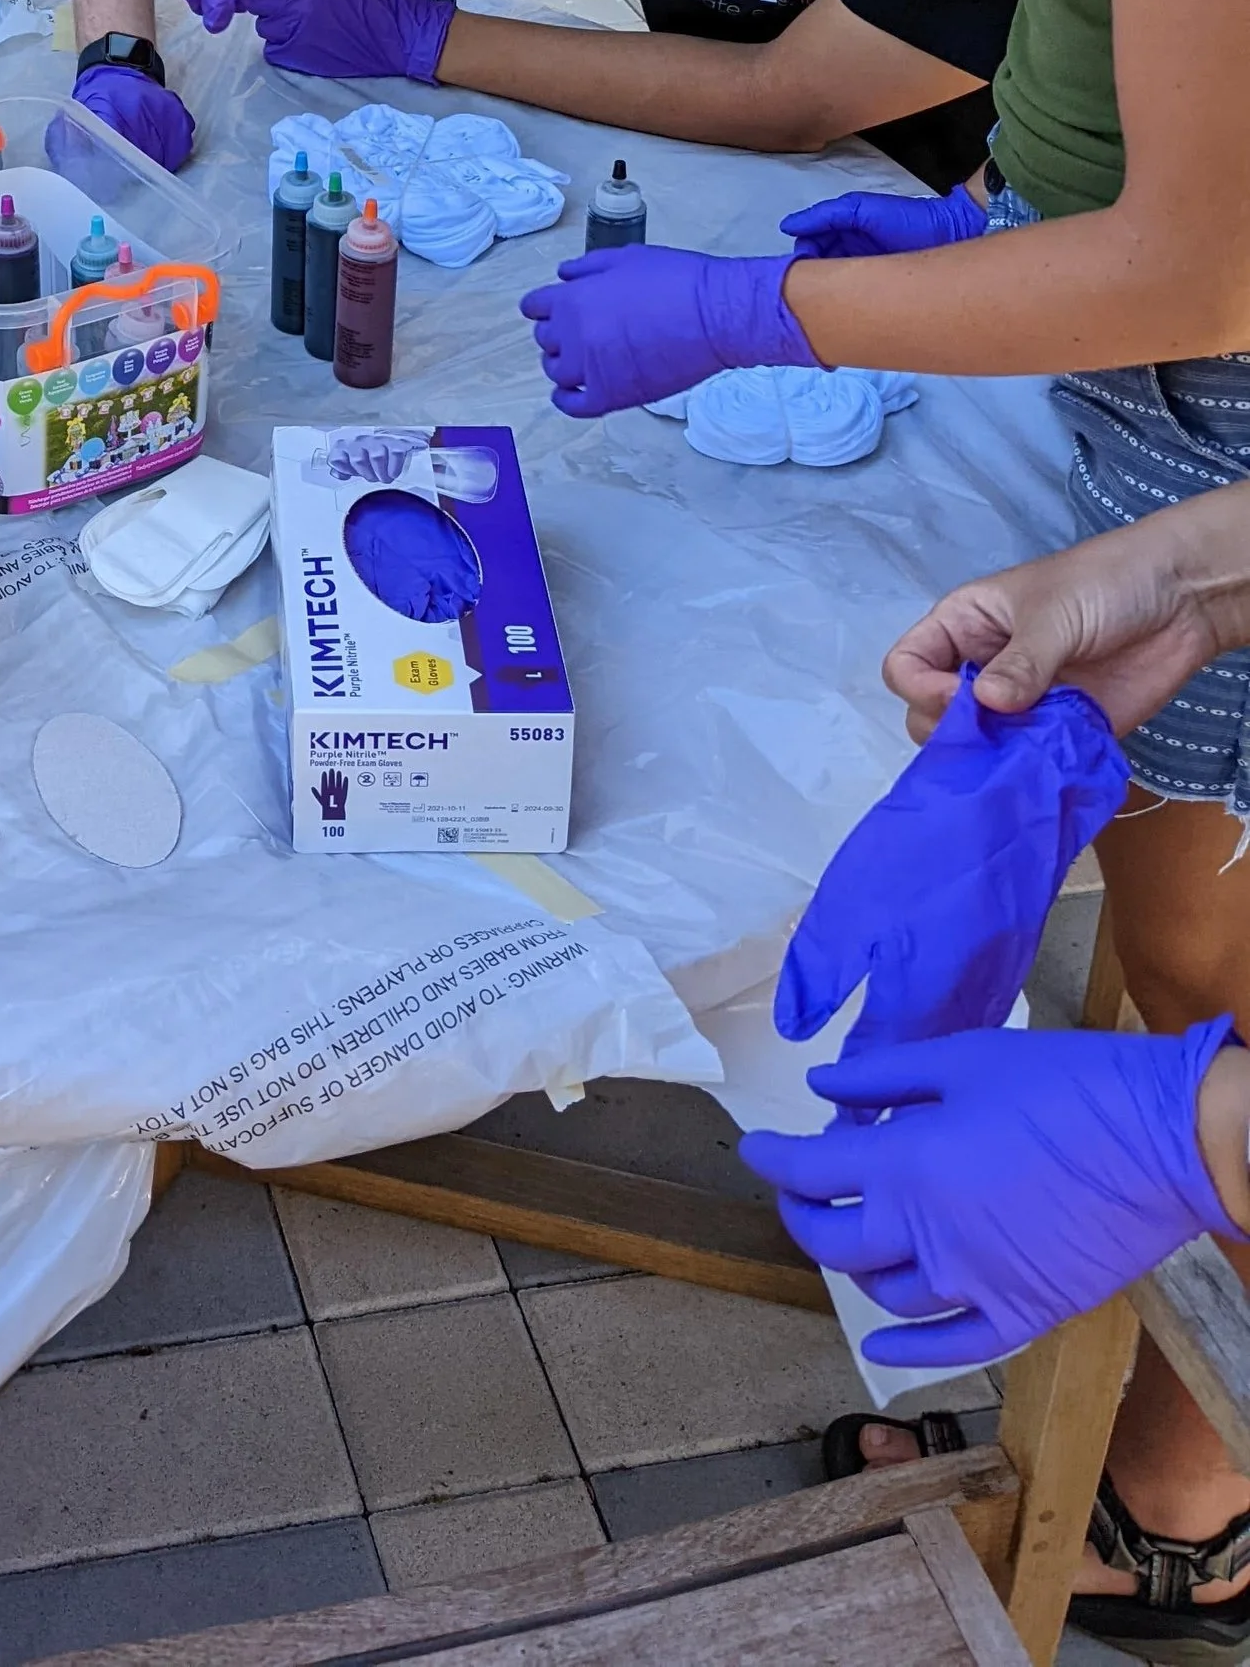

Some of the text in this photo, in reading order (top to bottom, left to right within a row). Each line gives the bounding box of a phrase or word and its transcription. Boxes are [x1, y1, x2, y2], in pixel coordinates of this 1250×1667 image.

[34, 561, 56, 576] TO
[504, 625, 542, 679] L 100
[350, 666, 362, 697] Purple
[410, 660, 421, 684] Exam
[428, 658, 439, 686] Gloves
[509, 728, 565, 741] 55083
[309, 759, 403, 768] Powder-Free Exam Gloves
[310, 750, 343, 761] Purple
[329, 795, 338, 808] L
[321, 826, 345, 838] 100
[424, 944, 454, 964] OR
[503, 942, 589, 989] WARNING:
[332, 956, 427, 1017] PLAYPENS.
[479, 984, 507, 1005] TO
[213, 929, 568, 1130] FROM BABIES AND CHILDREN. DO NOT USE
[290, 1011, 335, 1045] THIS
[424, 995, 477, 1040] AVOID
[250, 1036, 291, 1071] BAG
[345, 1032, 425, 1088] DANGER
[229, 1061, 250, 1084] IS
[190, 1075, 229, 1113] NOT
[319, 1080, 344, 1105] OF
[170, 1101, 186, 1119] A
[129, 1112, 174, 1135] TOY.
